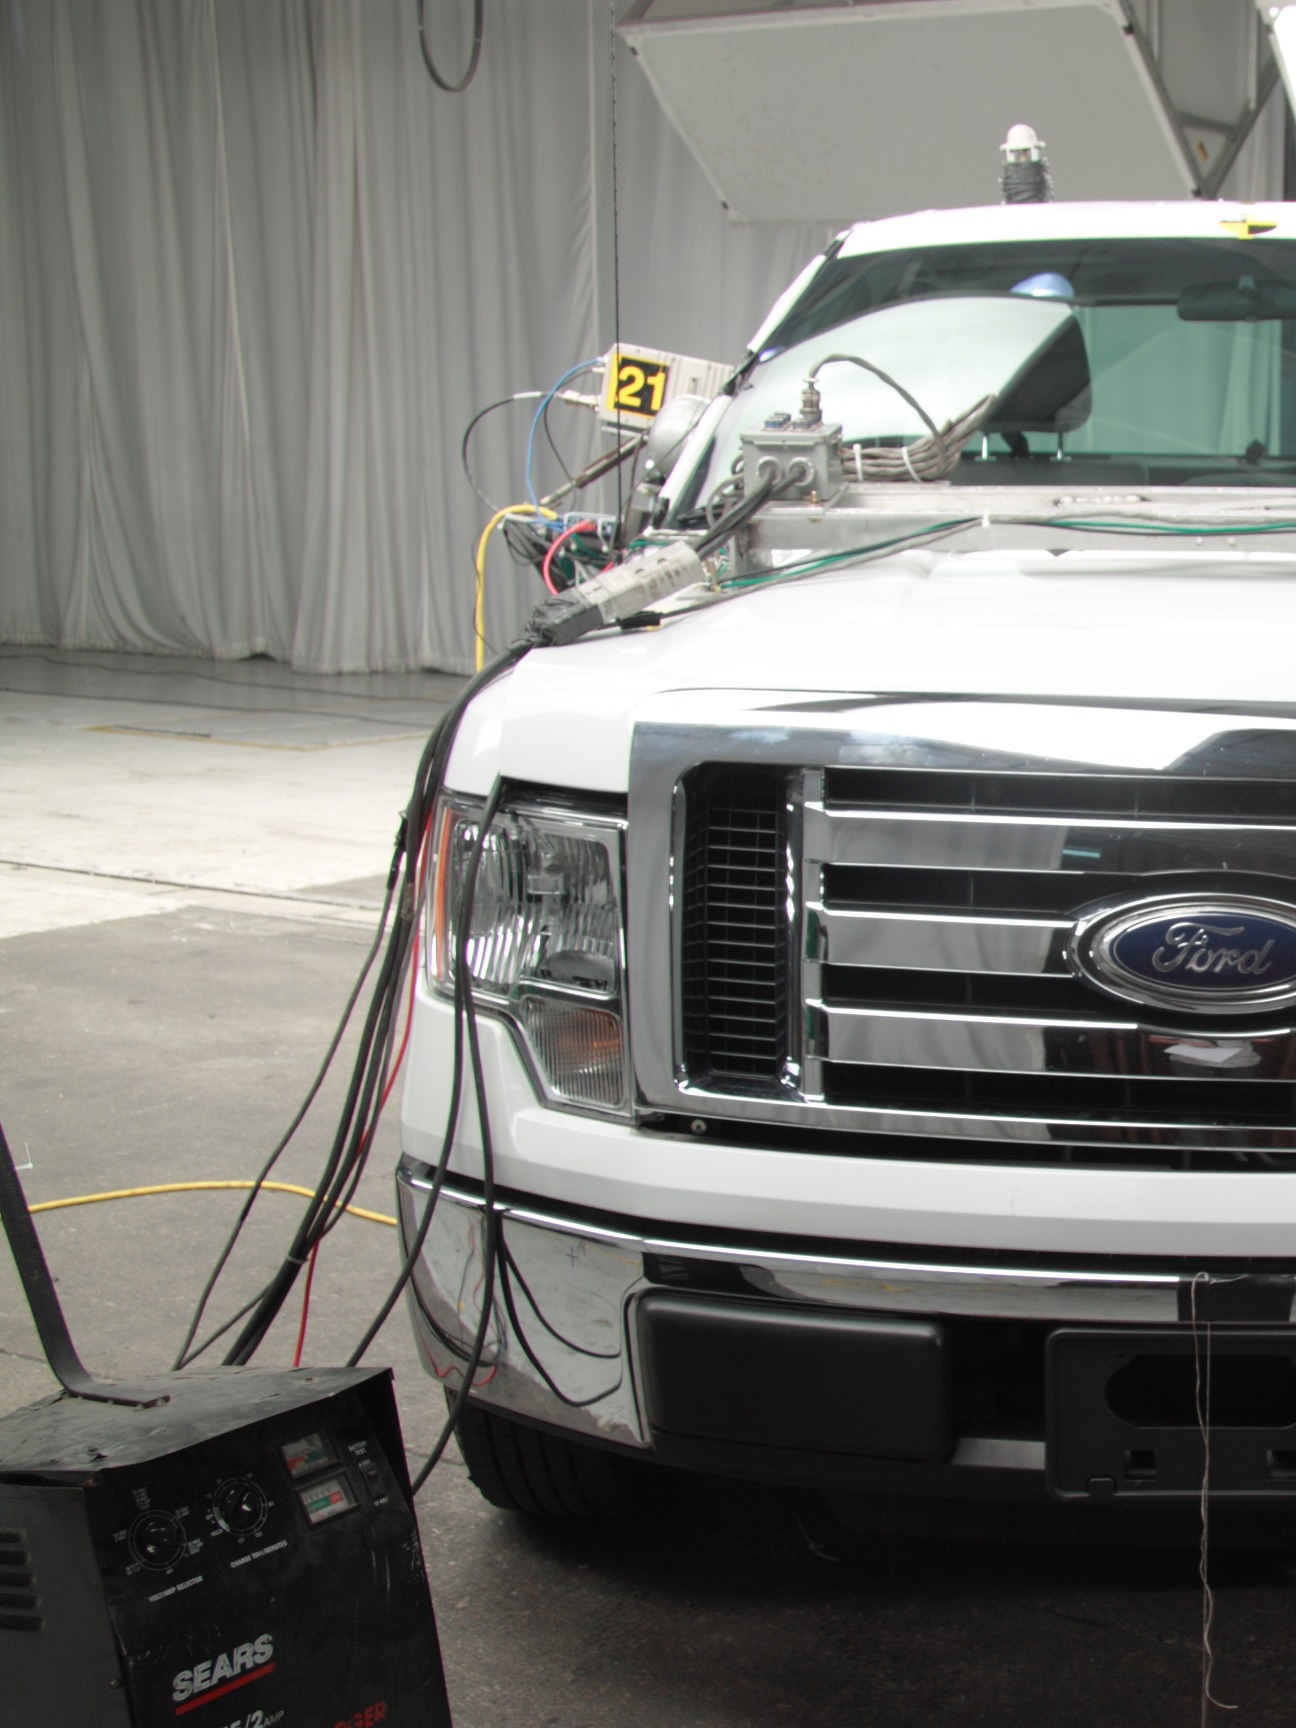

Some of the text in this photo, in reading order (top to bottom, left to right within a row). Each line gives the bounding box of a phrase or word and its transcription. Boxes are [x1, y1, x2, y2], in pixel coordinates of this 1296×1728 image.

[618, 365, 667, 411] 21
[1152, 922, 1275, 975] Ford
[176, 1575, 203, 1591] SELECTOR
[172, 1633, 273, 1702] SEARS
